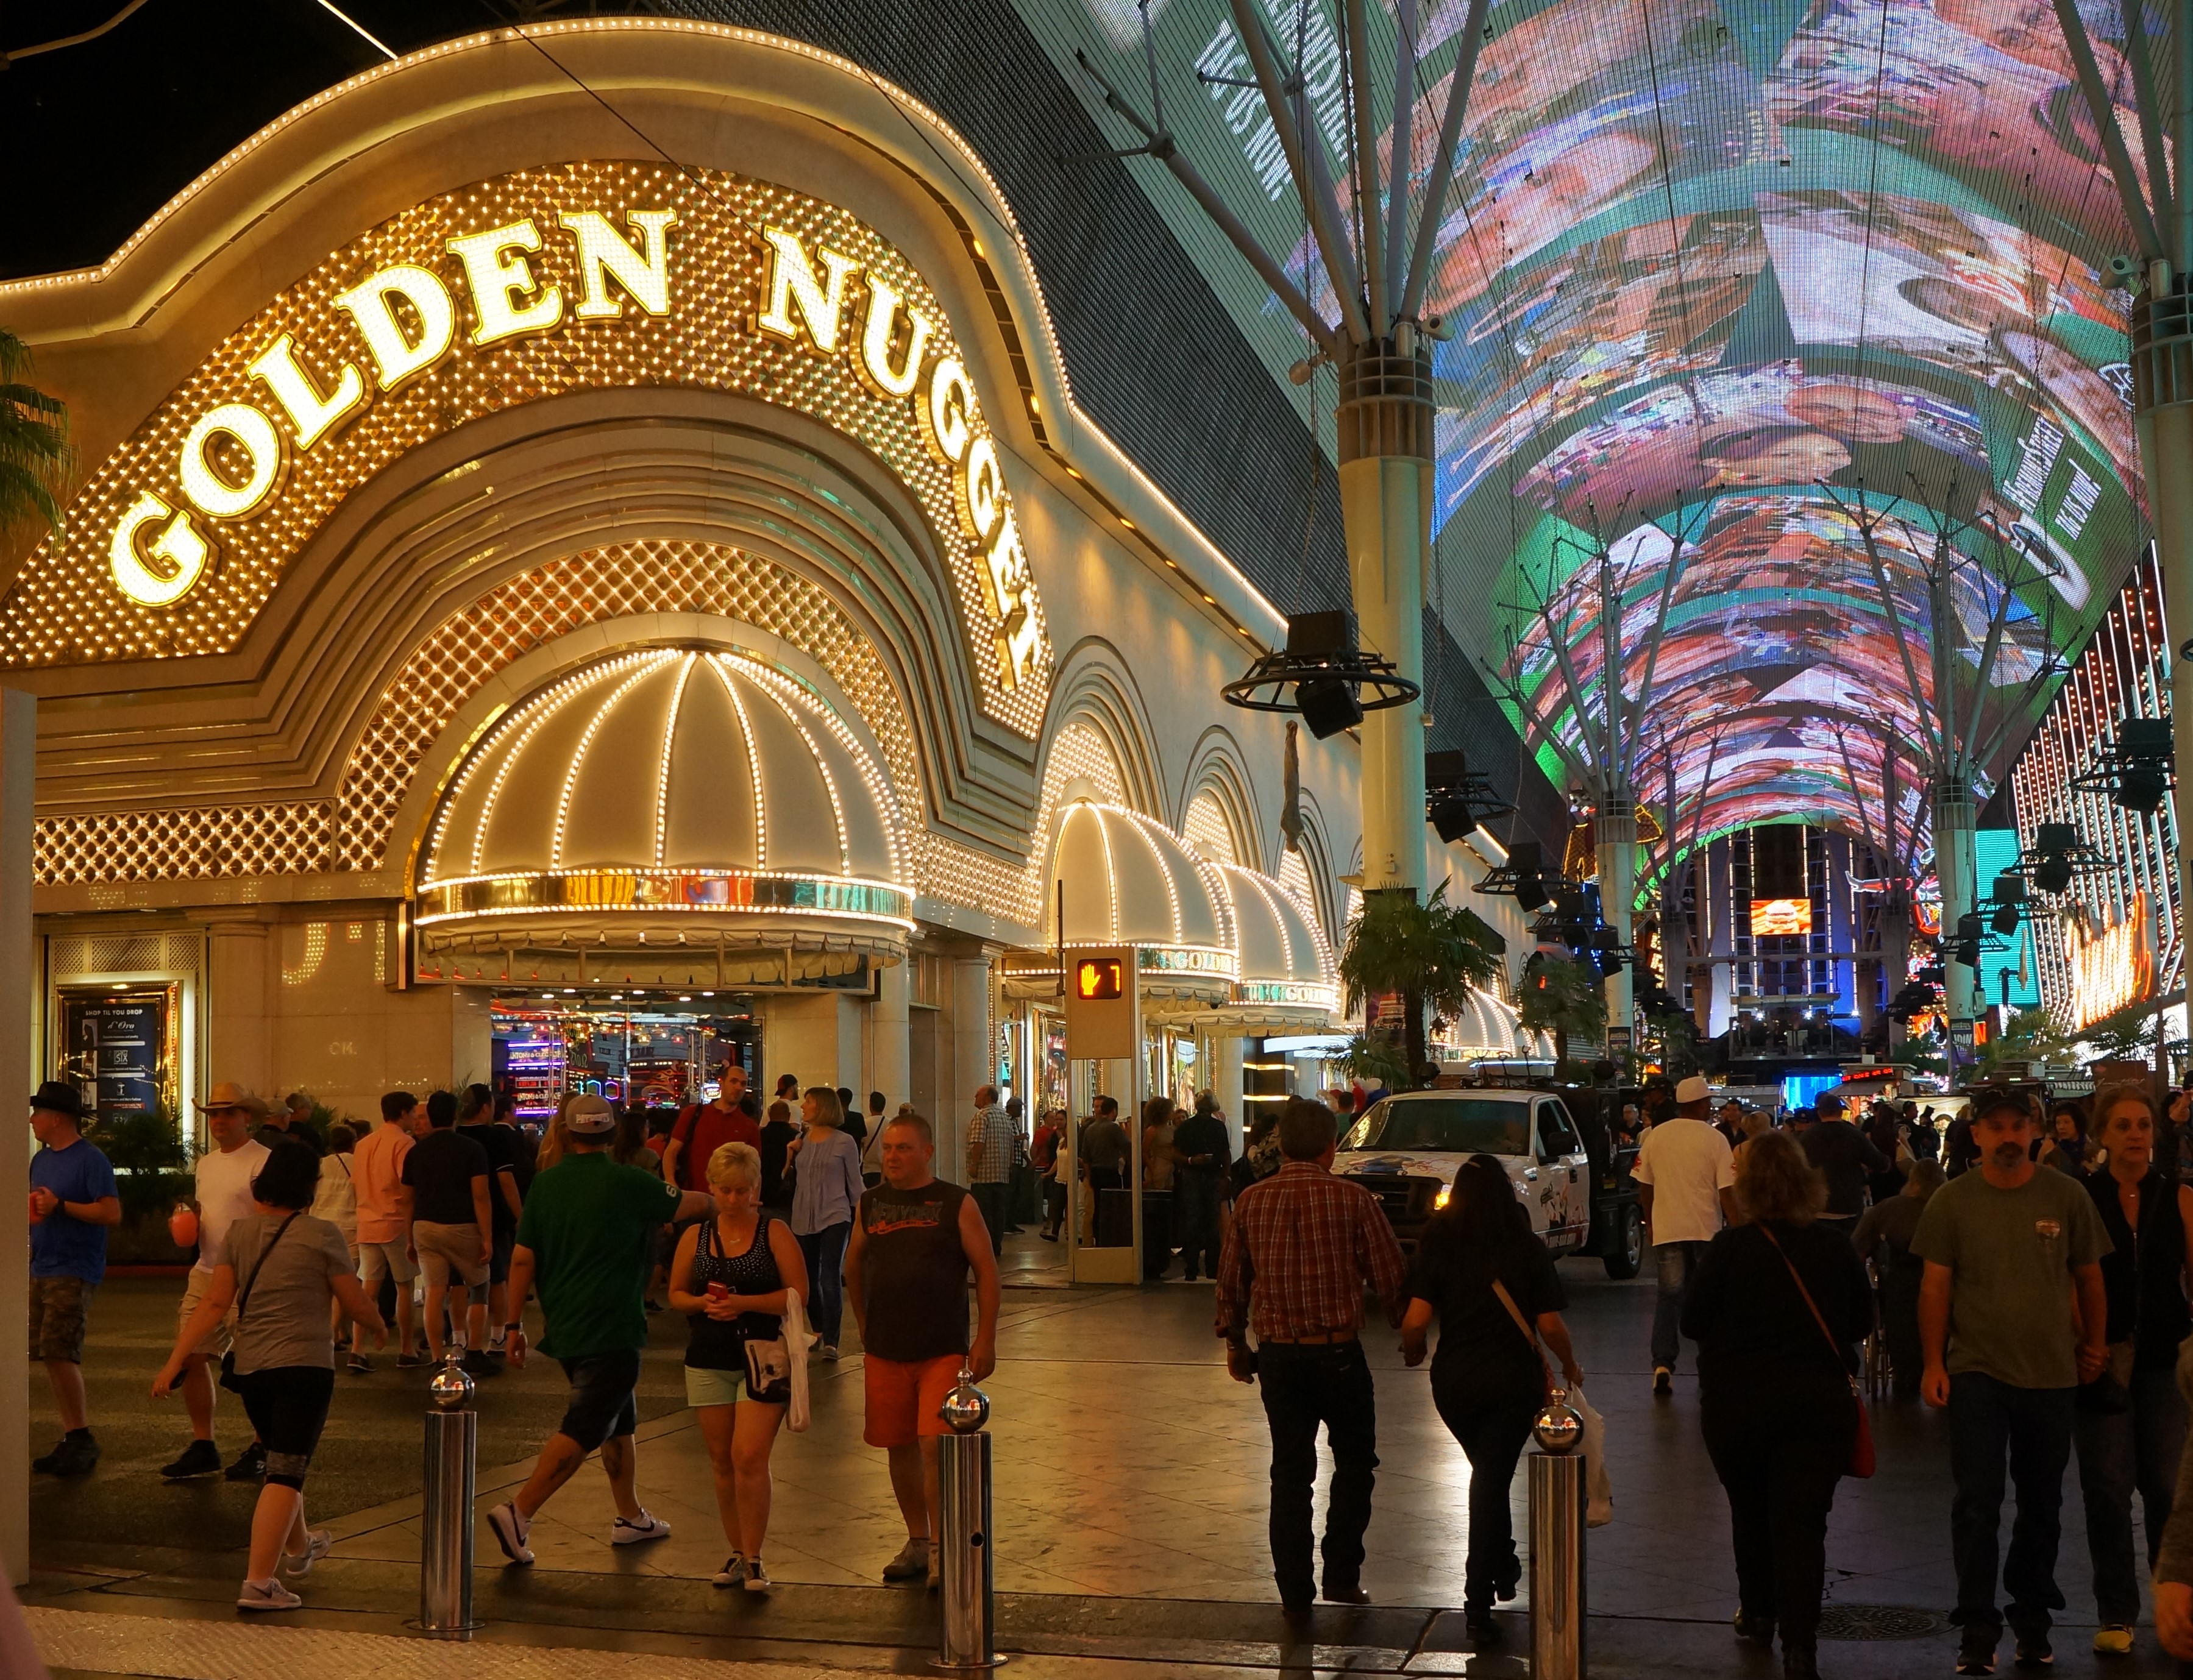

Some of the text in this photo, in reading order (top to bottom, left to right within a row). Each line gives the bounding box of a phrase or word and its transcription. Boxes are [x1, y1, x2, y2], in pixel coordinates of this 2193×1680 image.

[110, 209, 1040, 690] GOLDEN NUGGET
[2068, 458, 2102, 512] NOW!
[2062, 494, 2088, 523] US
[1111, 965, 1120, 991] 7
[1952, 1033, 1972, 1044] JOIN
